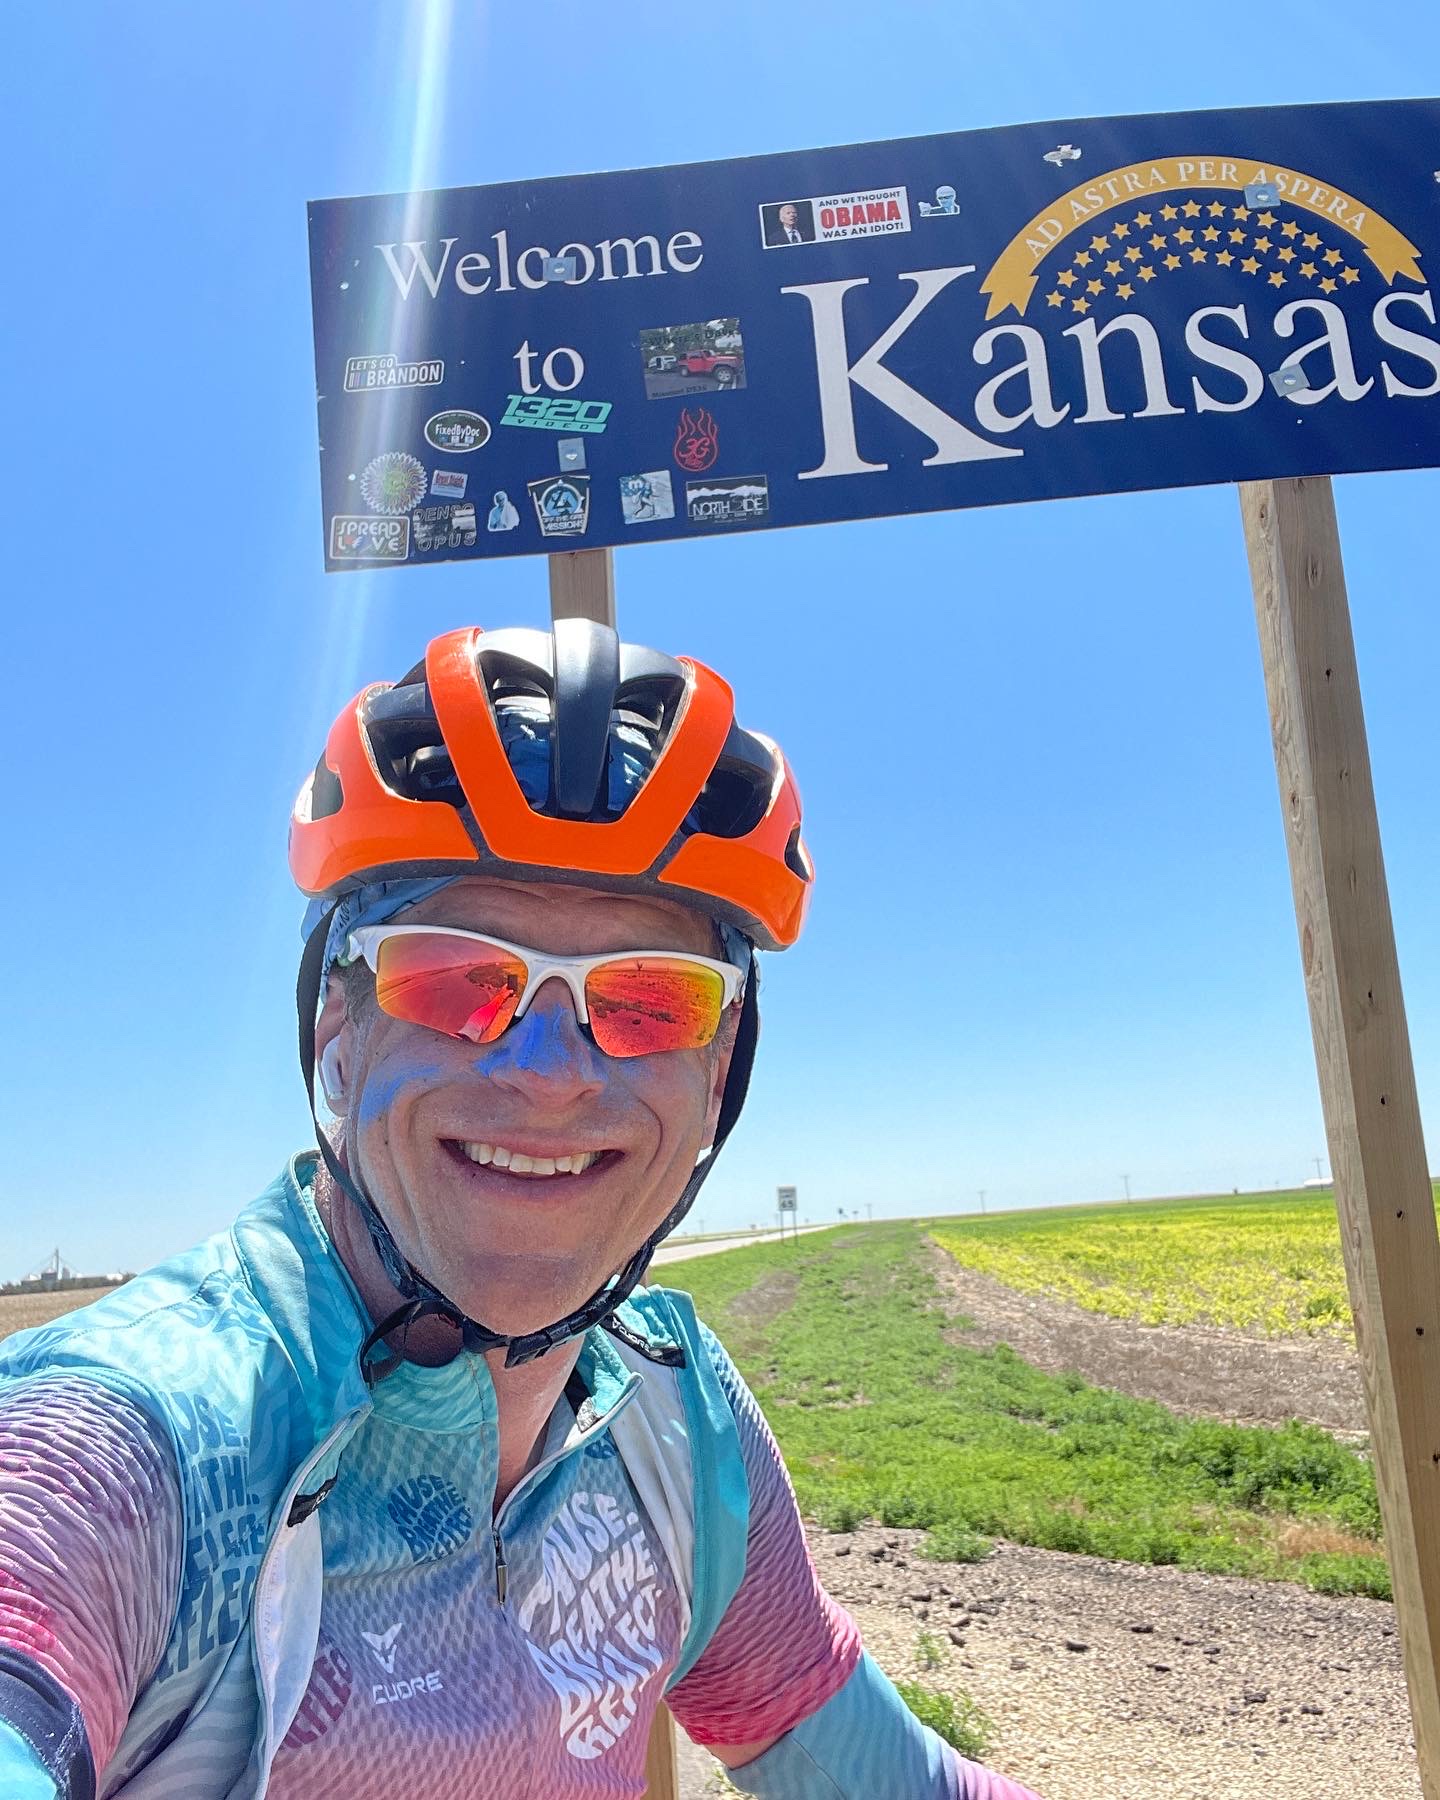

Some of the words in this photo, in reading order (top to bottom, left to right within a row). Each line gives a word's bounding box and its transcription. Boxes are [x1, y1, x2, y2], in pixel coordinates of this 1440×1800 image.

[818, 199, 839, 207] AND
[841, 196, 855, 204] WE
[857, 190, 901, 201] THOUGHT
[1024, 217, 1064, 257] AD
[1069, 164, 1167, 222] ASTRA
[1177, 160, 1240, 182] PER
[1249, 167, 1367, 232] ASPERA
[820, 200, 902, 229] OBAMA
[822, 228, 848, 239] WAS
[851, 226, 868, 235] AN
[870, 222, 904, 233] IDIOT!
[374, 229, 704, 302] Welcome
[350, 360, 376, 371] LET'S
[379, 358, 394, 368] GO
[366, 364, 440, 387] BRANDON
[512, 340, 585, 395] to
[506, 394, 612, 423] 1320
[435, 423, 480, 439] FixedByDoc
[517, 418, 590, 430] VIDEO
[692, 501, 731, 516] NORTH
[372, 1670, 444, 1705] CUORE
